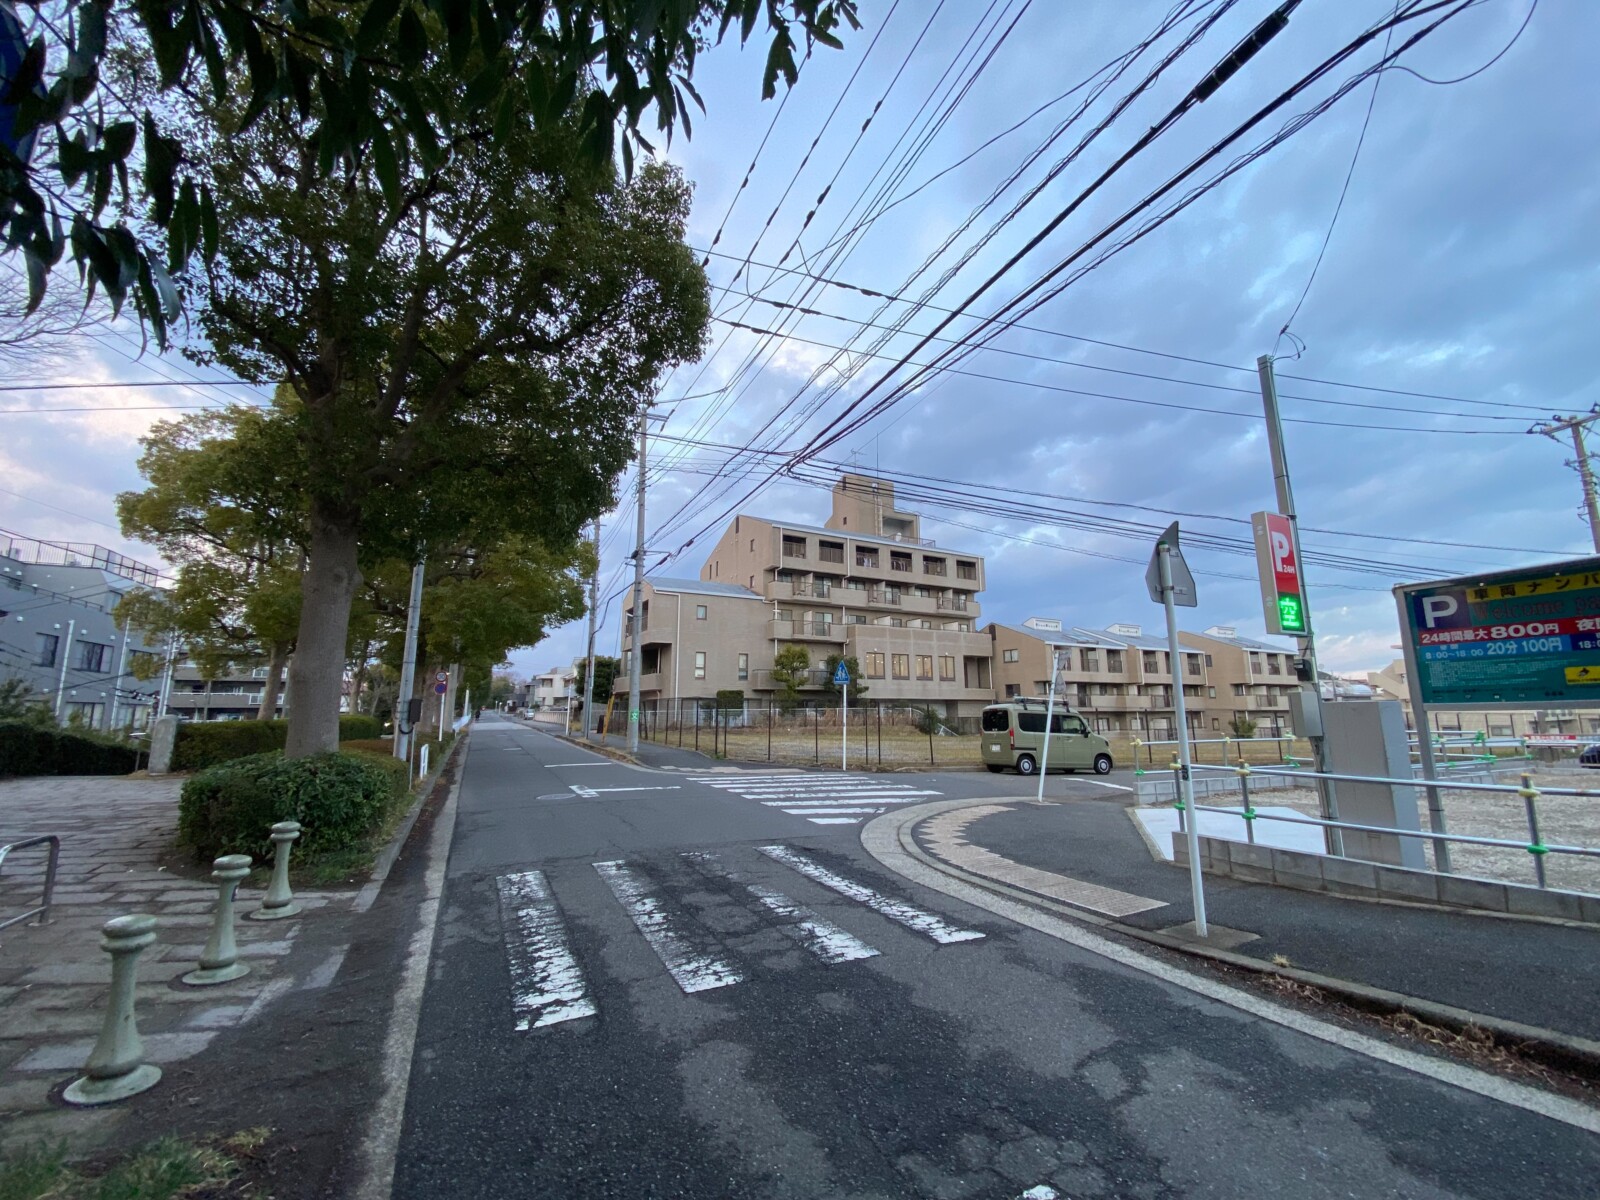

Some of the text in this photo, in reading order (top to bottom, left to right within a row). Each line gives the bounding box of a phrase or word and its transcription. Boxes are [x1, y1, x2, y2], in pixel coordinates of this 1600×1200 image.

[1271, 531, 1290, 572] P
[1283, 565, 1295, 574] 24H
[1280, 598, 1300, 627] 空
[1422, 595, 1458, 628] P
[1472, 599, 1566, 621] Welcome
[1575, 617, 1600, 632] 夜
[1522, 637, 1562, 652] 100円
